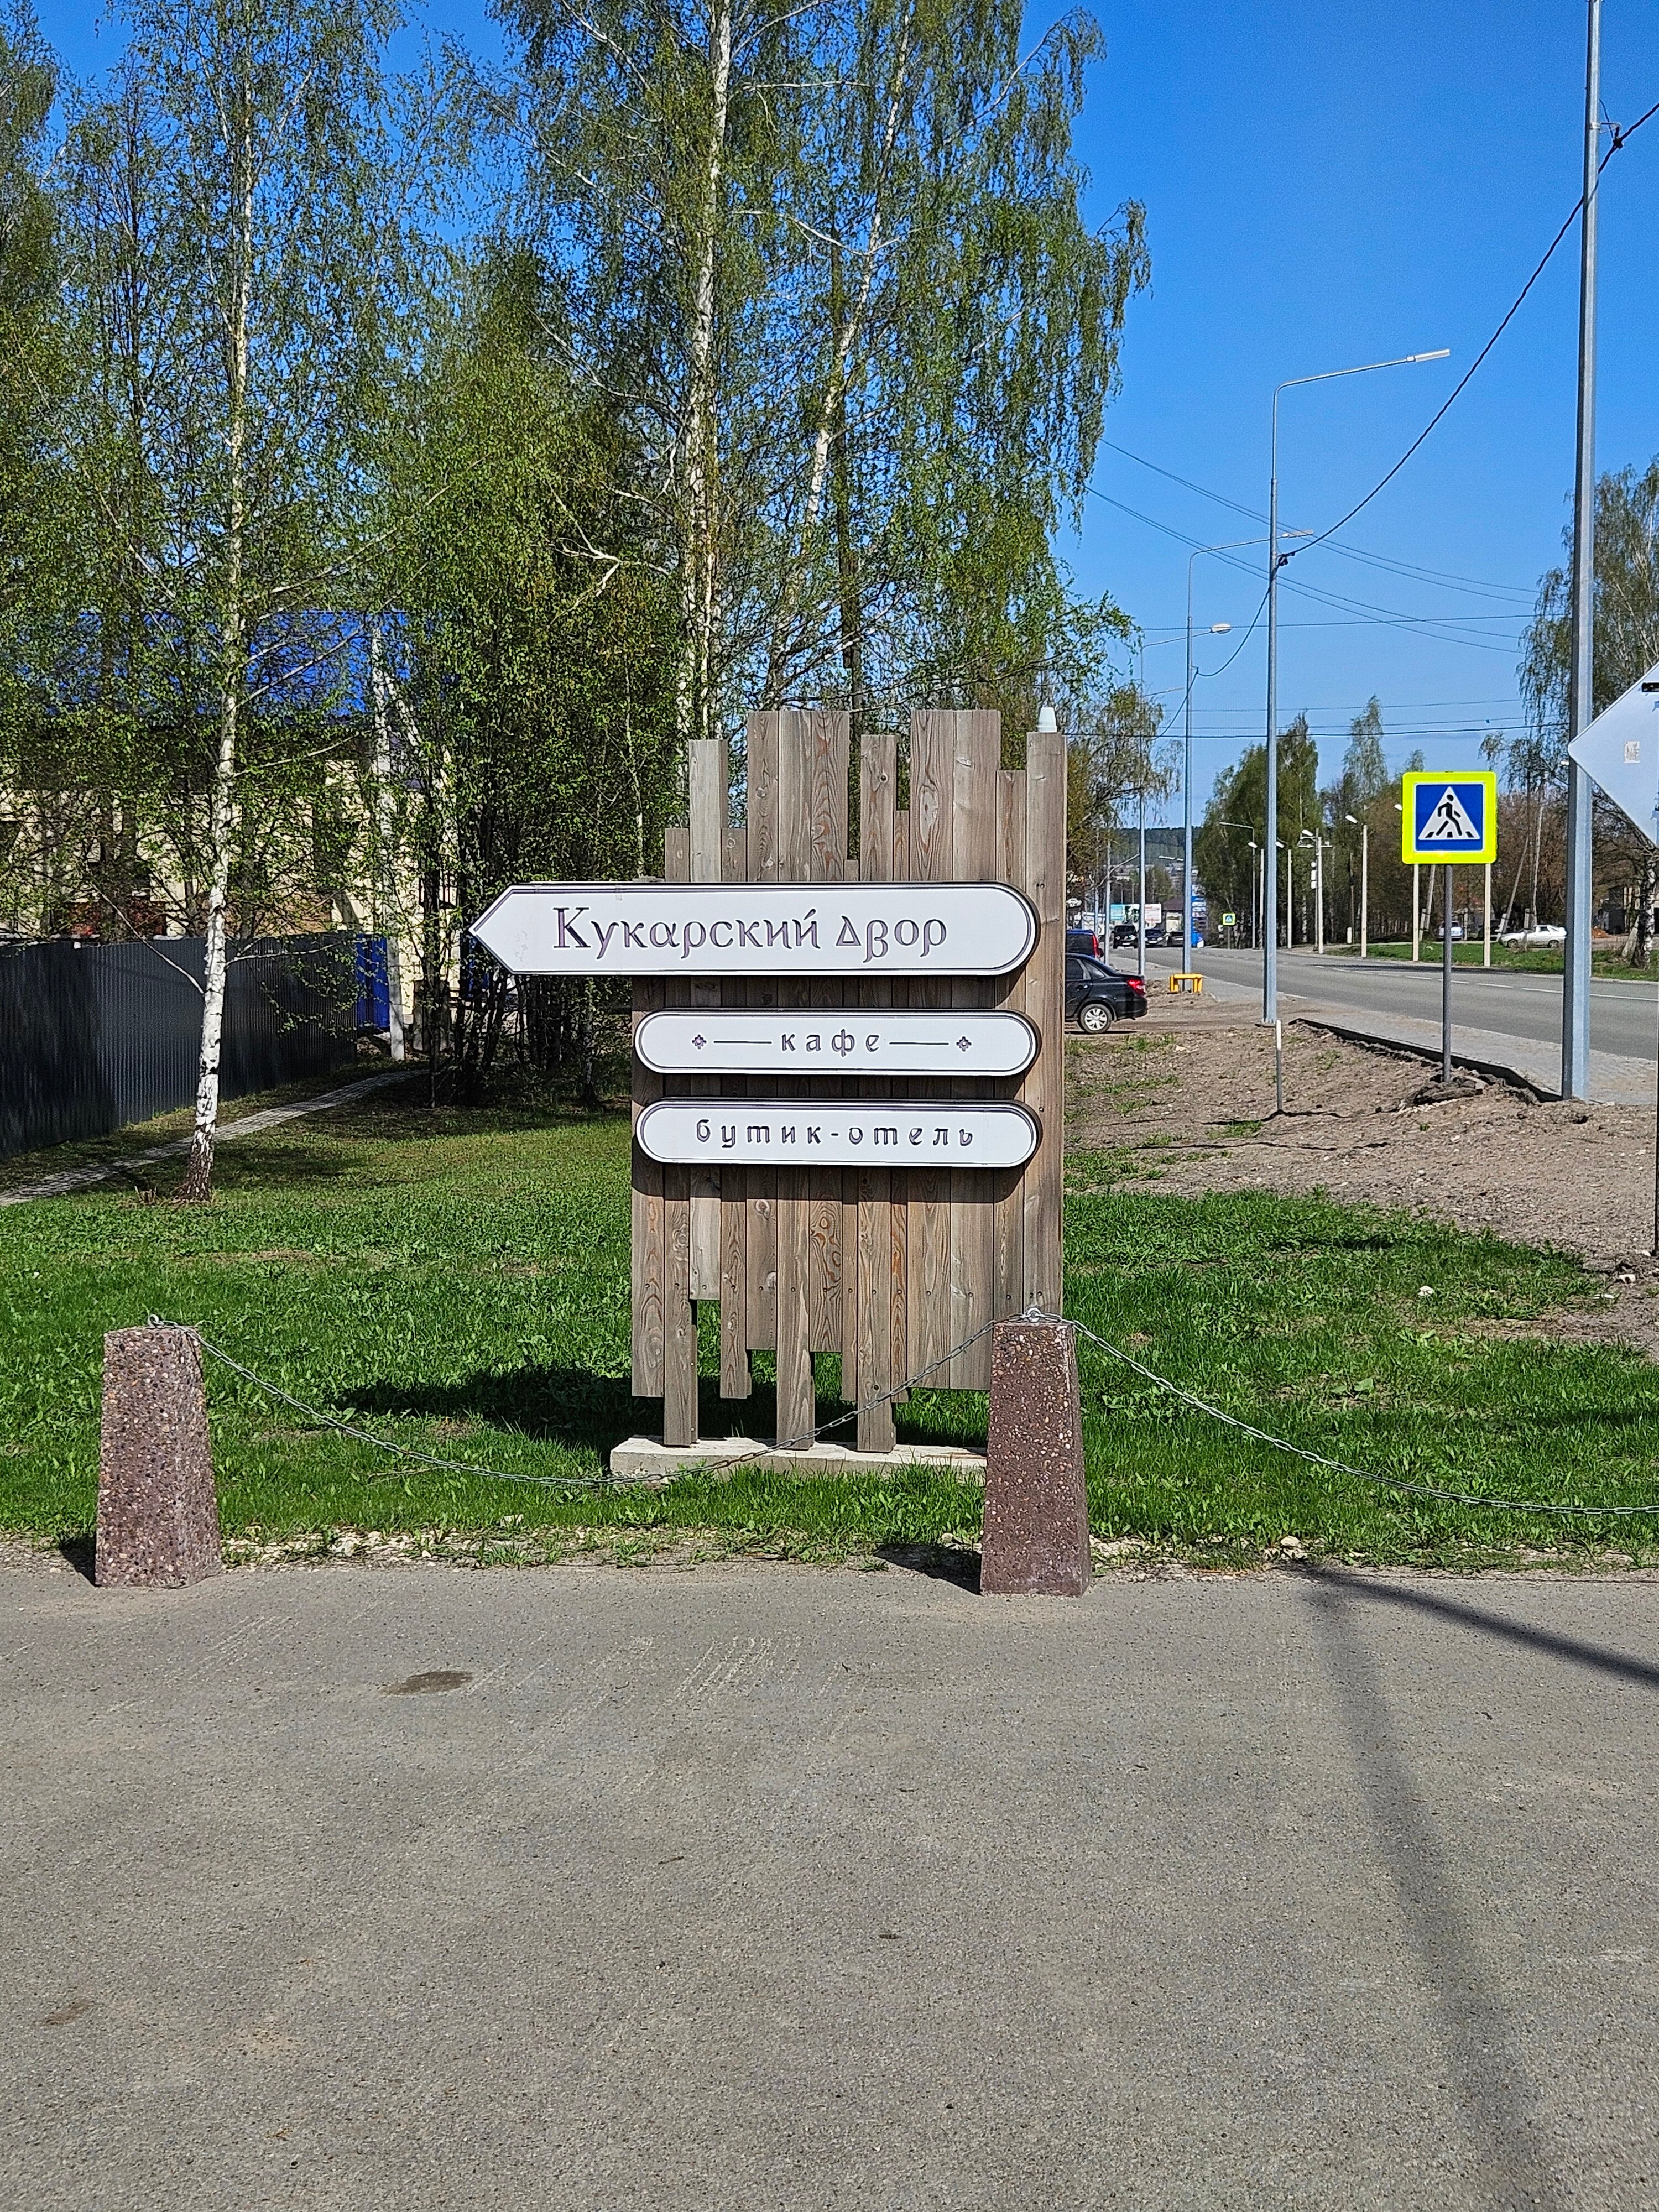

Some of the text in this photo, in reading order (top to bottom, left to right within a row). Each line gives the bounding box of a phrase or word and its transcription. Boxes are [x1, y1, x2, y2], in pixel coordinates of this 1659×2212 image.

[552, 907, 821, 959] Кукарский
[781, 1029, 880, 1057] кафе
[696, 1119, 973, 1149] бутик-отель
